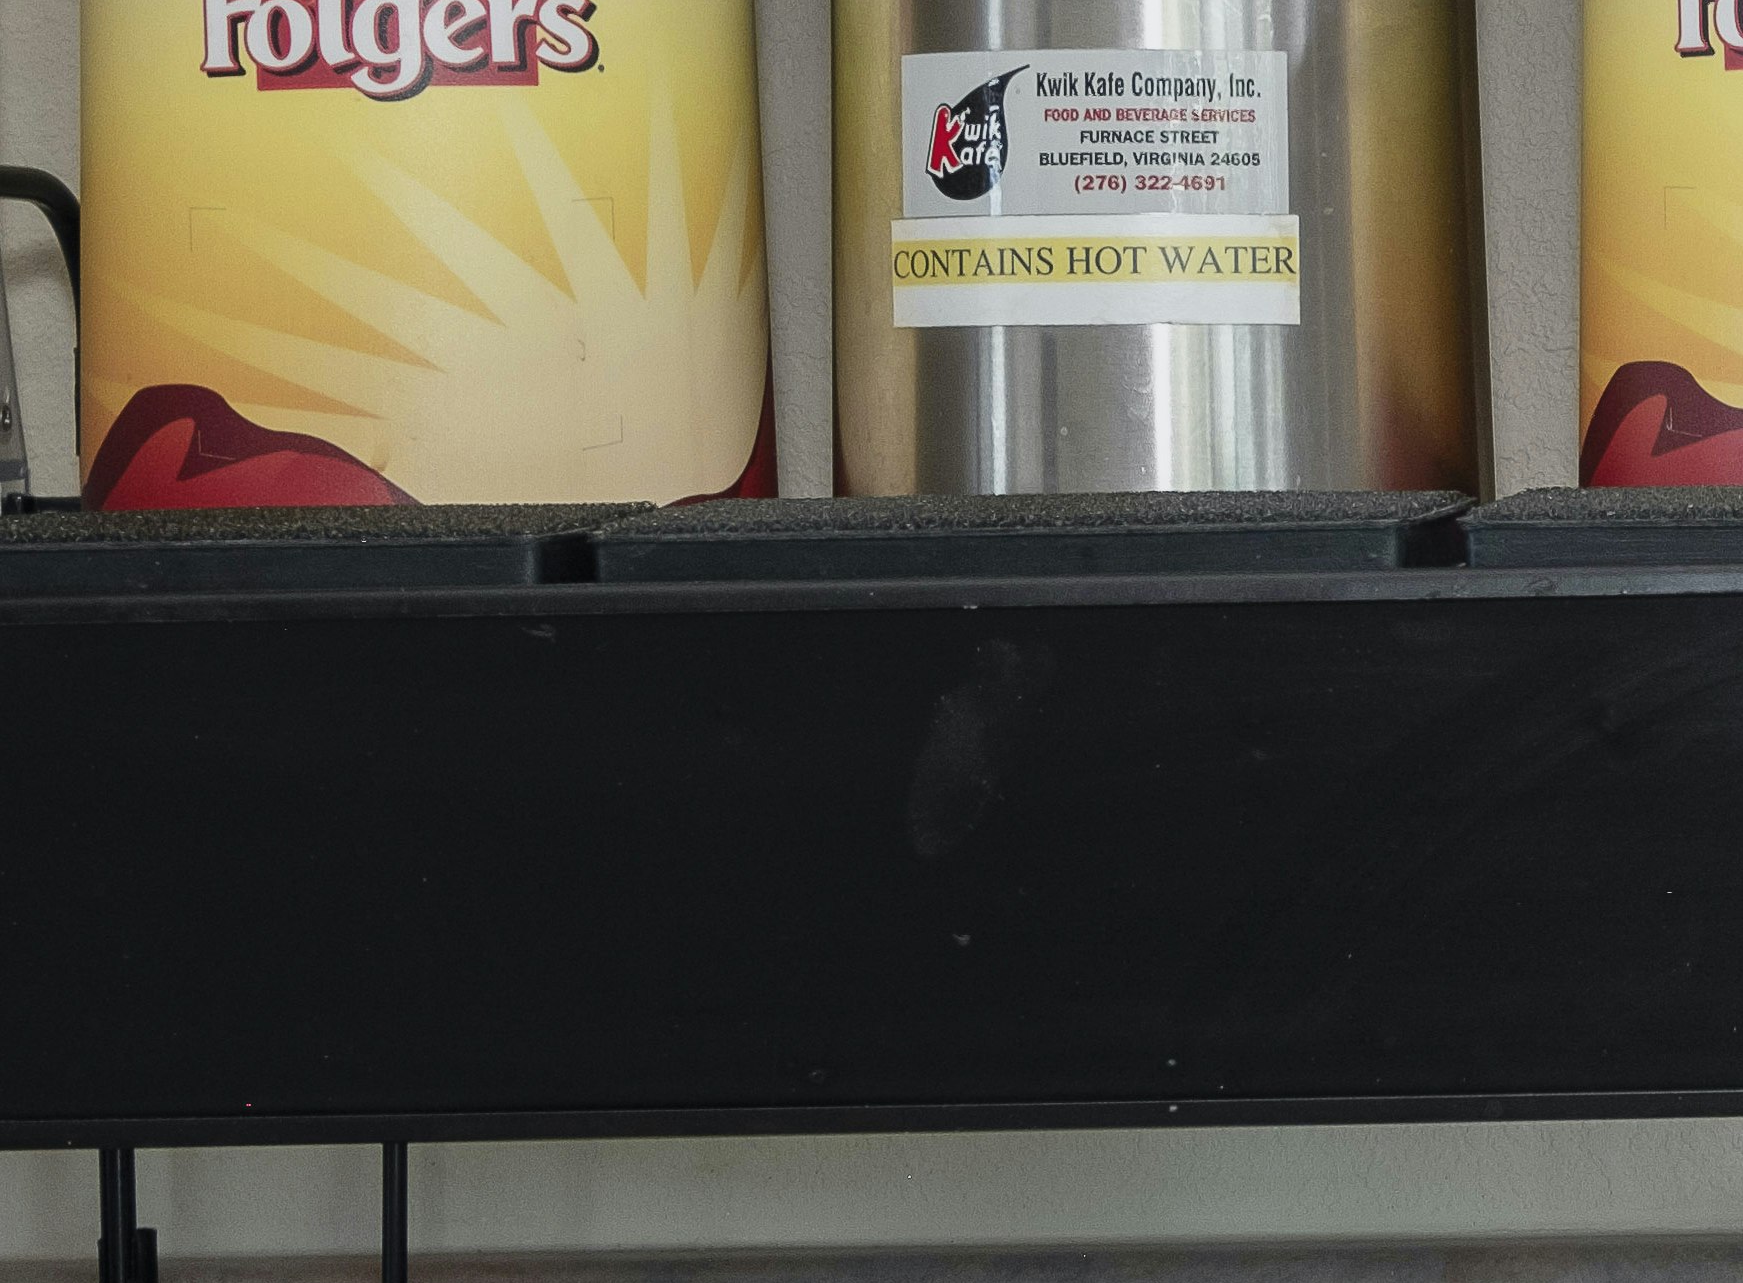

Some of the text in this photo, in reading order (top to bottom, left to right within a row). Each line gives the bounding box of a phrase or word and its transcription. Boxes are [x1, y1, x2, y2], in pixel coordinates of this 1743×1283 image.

[1036, 71, 1261, 102] Kwik Kafe Company, Inc.
[1044, 108, 1257, 123] FOOD AND BEVERAGE SERVICES
[1080, 130, 1219, 144] FURNACE STREET
[1039, 152, 1261, 167] BLUEFIELD, VIRGINIA 24605
[1074, 175, 1225, 194] (276) 322-4691
[893, 245, 1297, 278] CONTAINS HOT WATER
